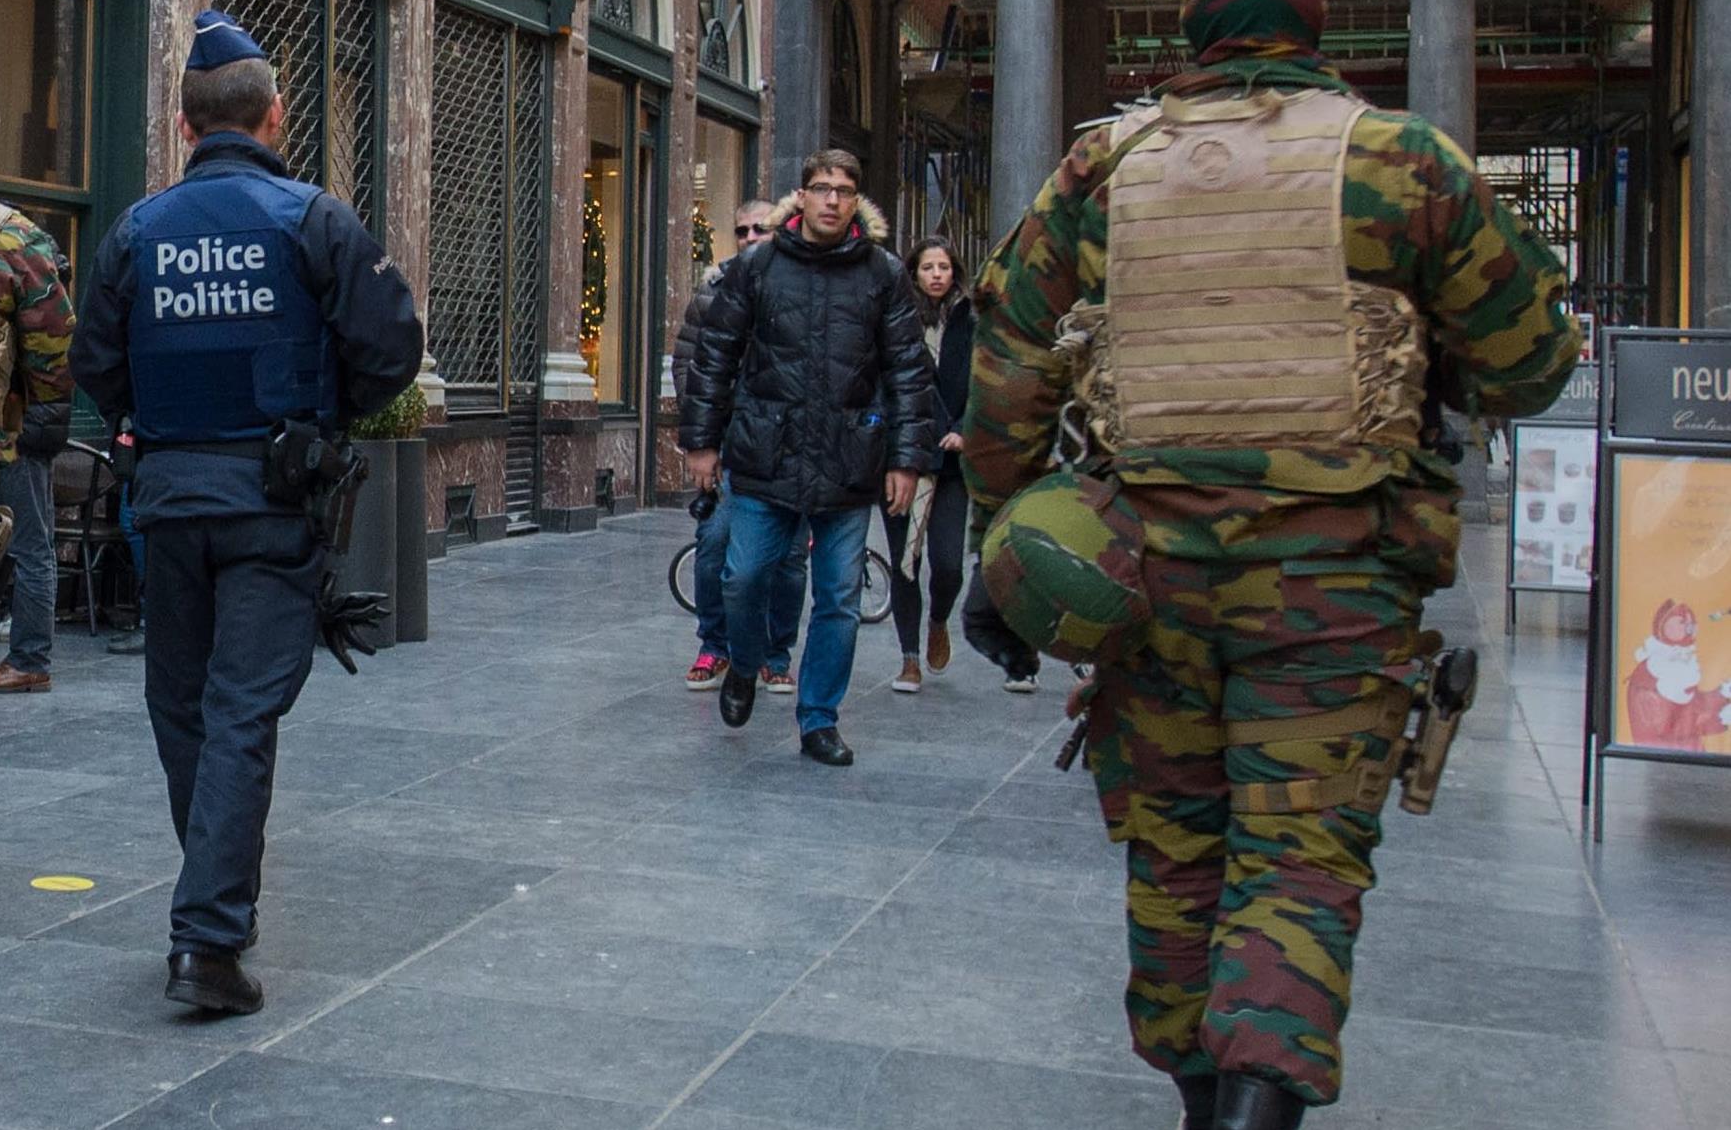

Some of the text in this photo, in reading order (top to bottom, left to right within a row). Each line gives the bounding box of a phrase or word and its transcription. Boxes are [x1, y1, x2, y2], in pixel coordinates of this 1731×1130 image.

[157, 238, 265, 275] Police
[154, 279, 274, 318] Politie
[1673, 366, 1731, 401] neu
